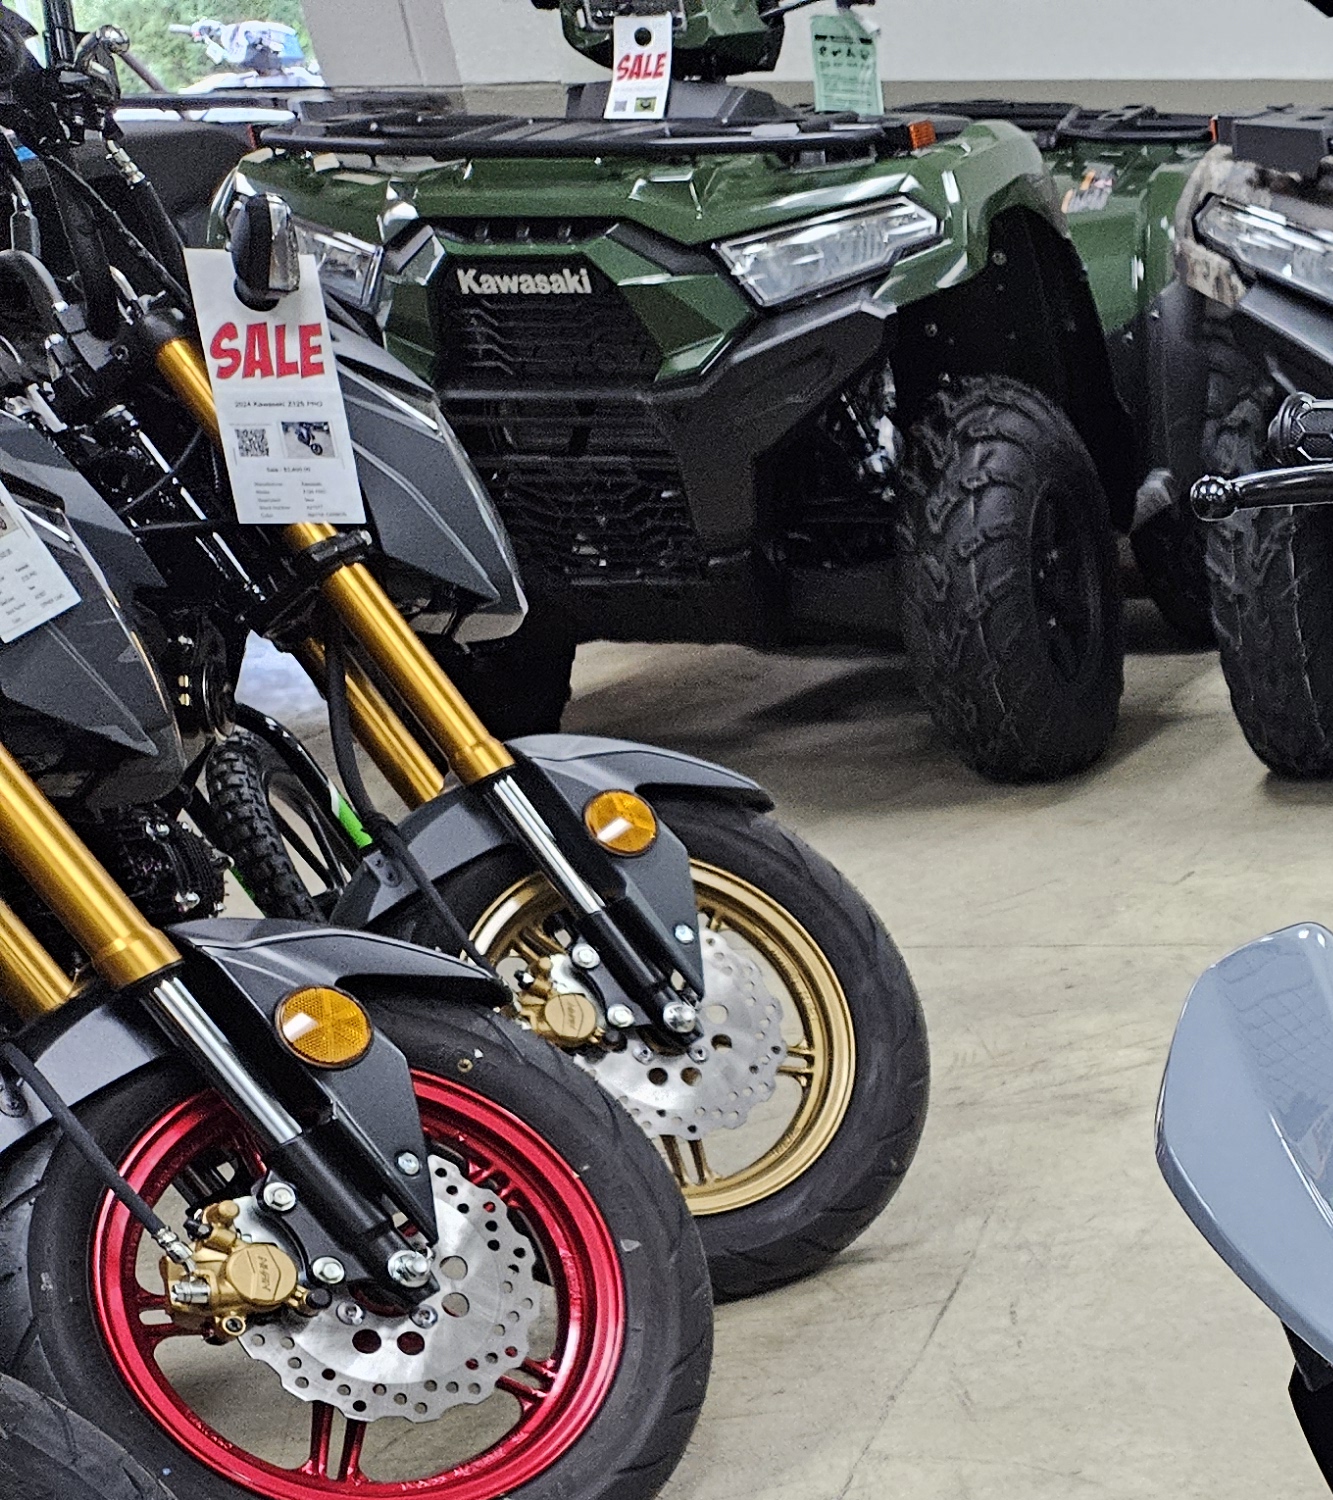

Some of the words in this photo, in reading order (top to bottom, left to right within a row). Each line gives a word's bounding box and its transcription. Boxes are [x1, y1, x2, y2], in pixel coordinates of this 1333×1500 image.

[617, 51, 667, 81] SALE
[457, 267, 592, 295] Kawasaki
[210, 321, 326, 379] SALE
